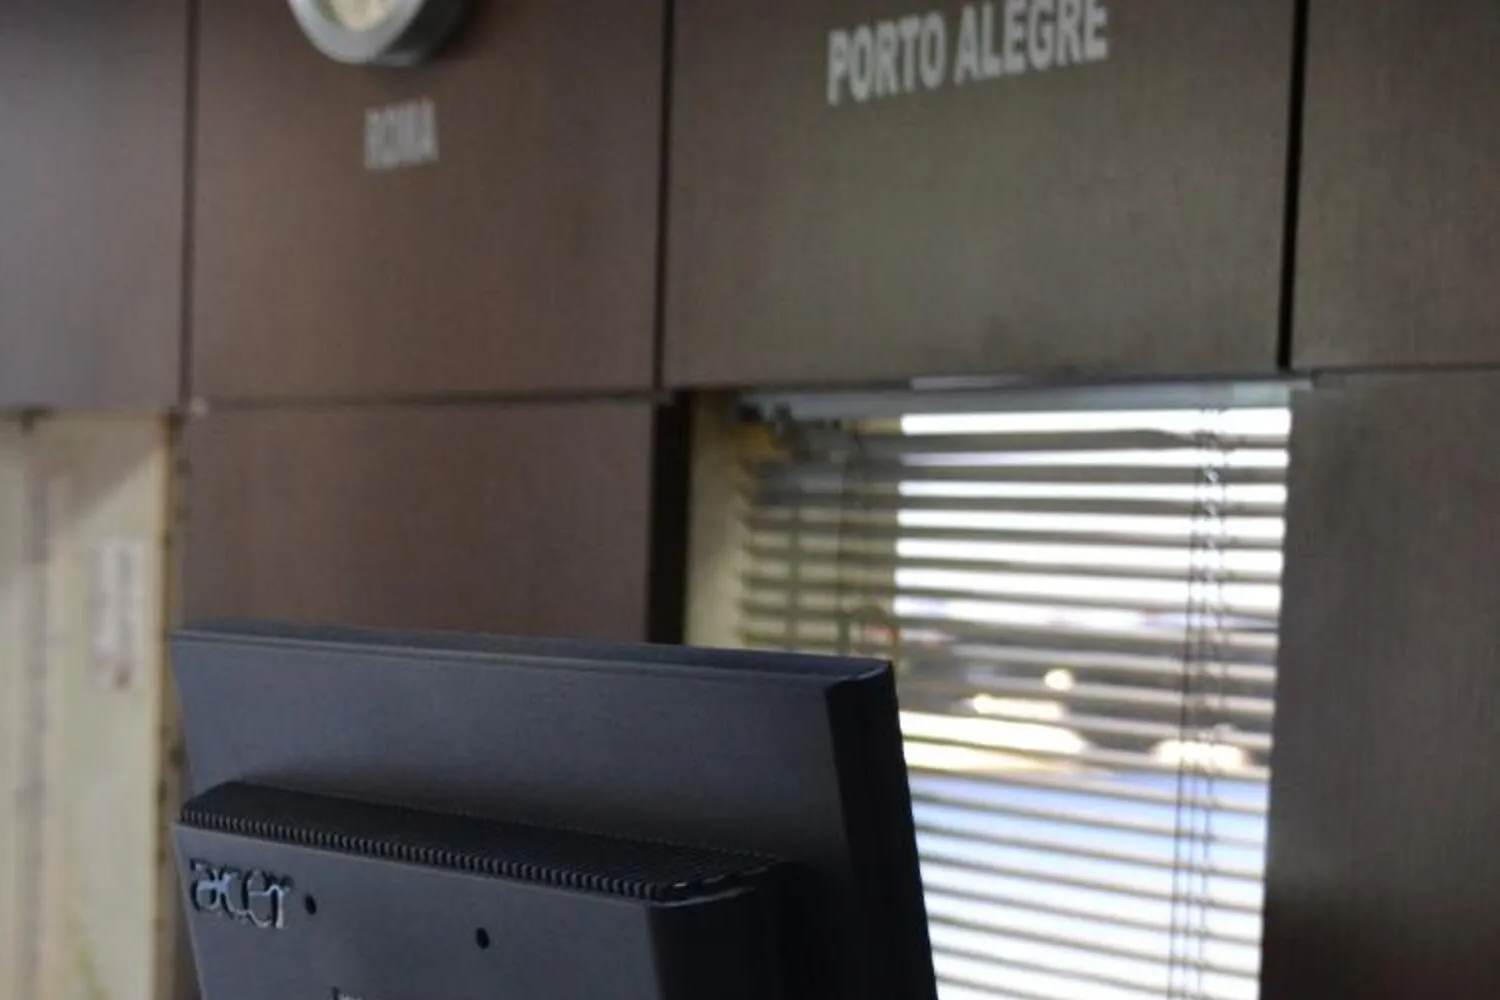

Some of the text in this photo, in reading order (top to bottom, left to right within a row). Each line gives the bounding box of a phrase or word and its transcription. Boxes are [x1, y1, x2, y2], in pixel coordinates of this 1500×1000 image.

[826, 0, 1109, 107] PORTO ALEGRE
[190, 858, 295, 930] acer
